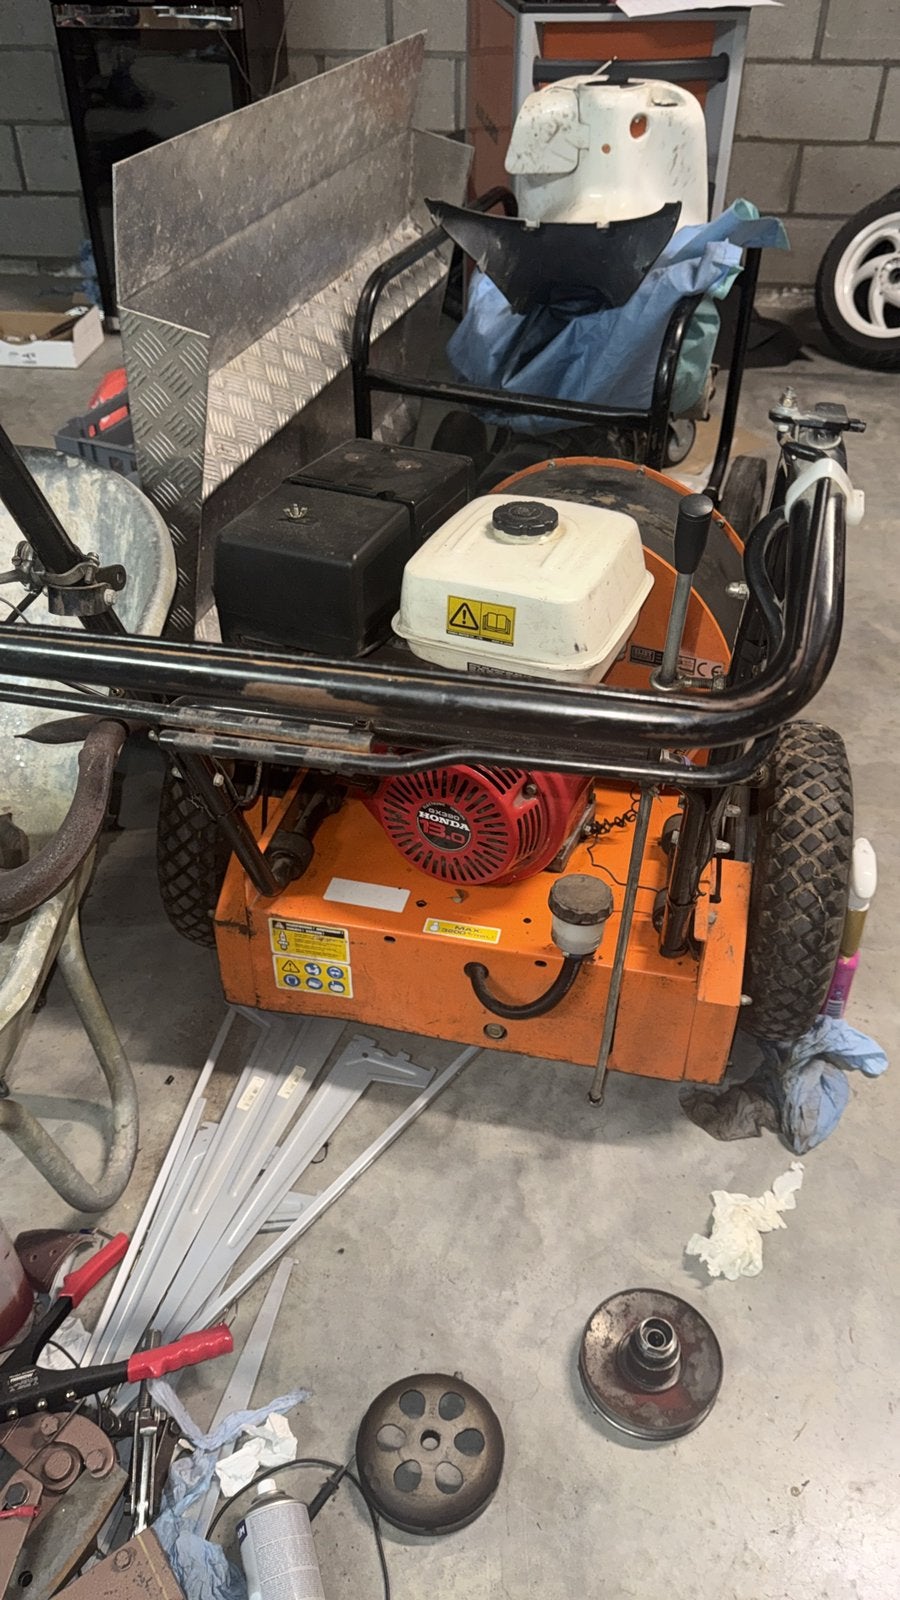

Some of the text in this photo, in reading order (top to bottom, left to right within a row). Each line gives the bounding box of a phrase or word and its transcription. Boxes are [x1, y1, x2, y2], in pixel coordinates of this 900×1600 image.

[418, 811, 470, 832] HONDA
[428, 808, 460, 821] GX390
[420, 819, 466, 845] 13.0
[454, 925, 480, 933] MAX
